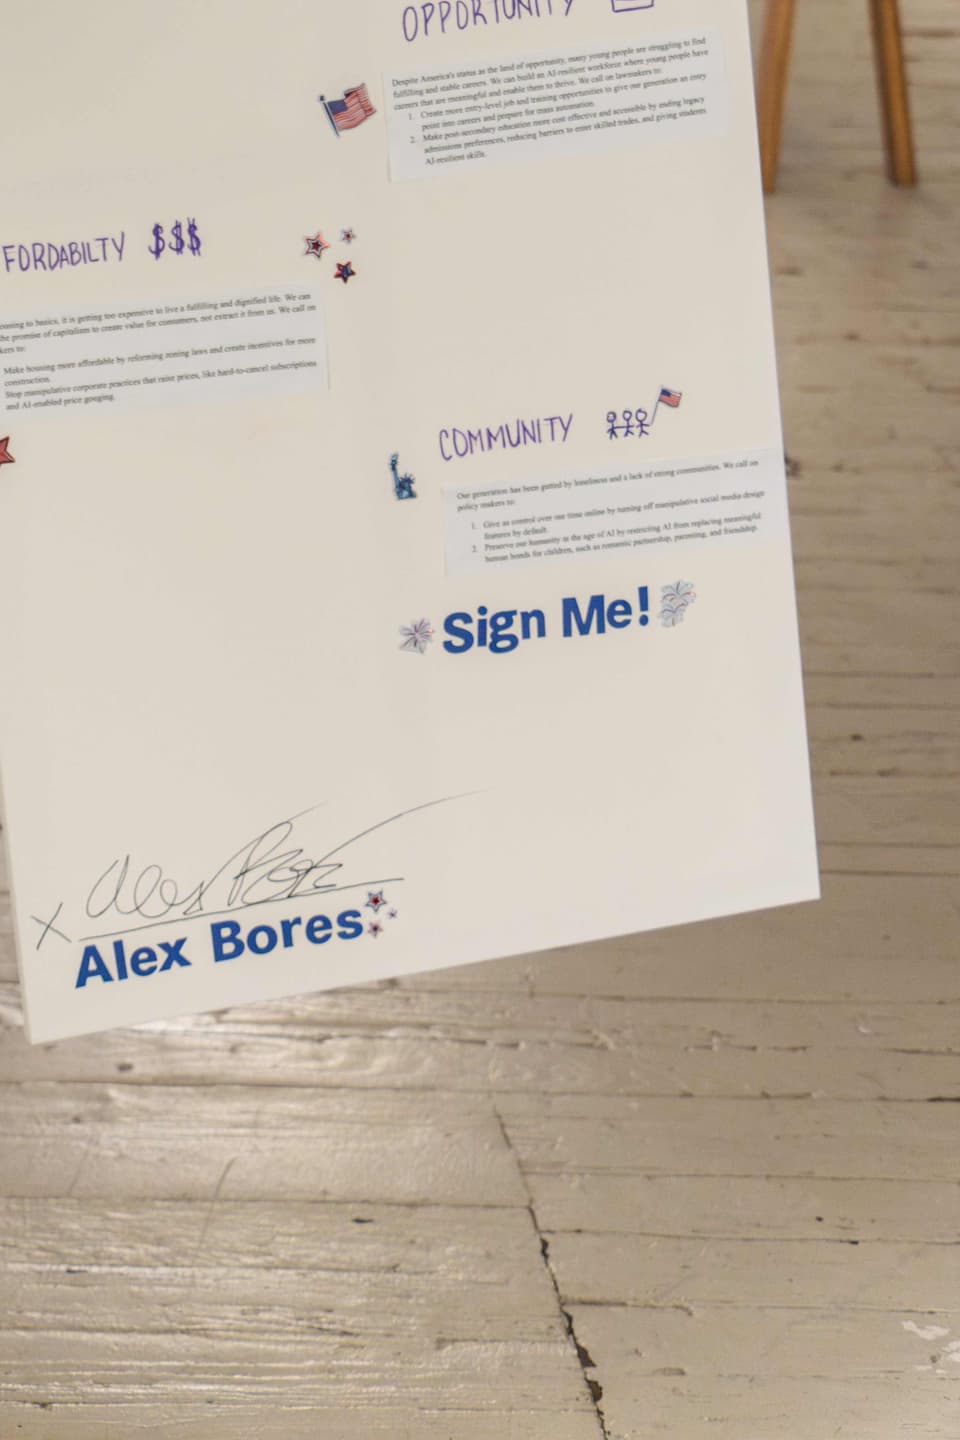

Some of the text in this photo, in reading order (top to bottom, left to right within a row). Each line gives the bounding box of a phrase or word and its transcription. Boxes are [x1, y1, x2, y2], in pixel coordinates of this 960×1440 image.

[439, 414, 573, 462] COMMUNITY
[442, 585, 650, 655] Sign Me!
[74, 908, 363, 989] Alex Bores
